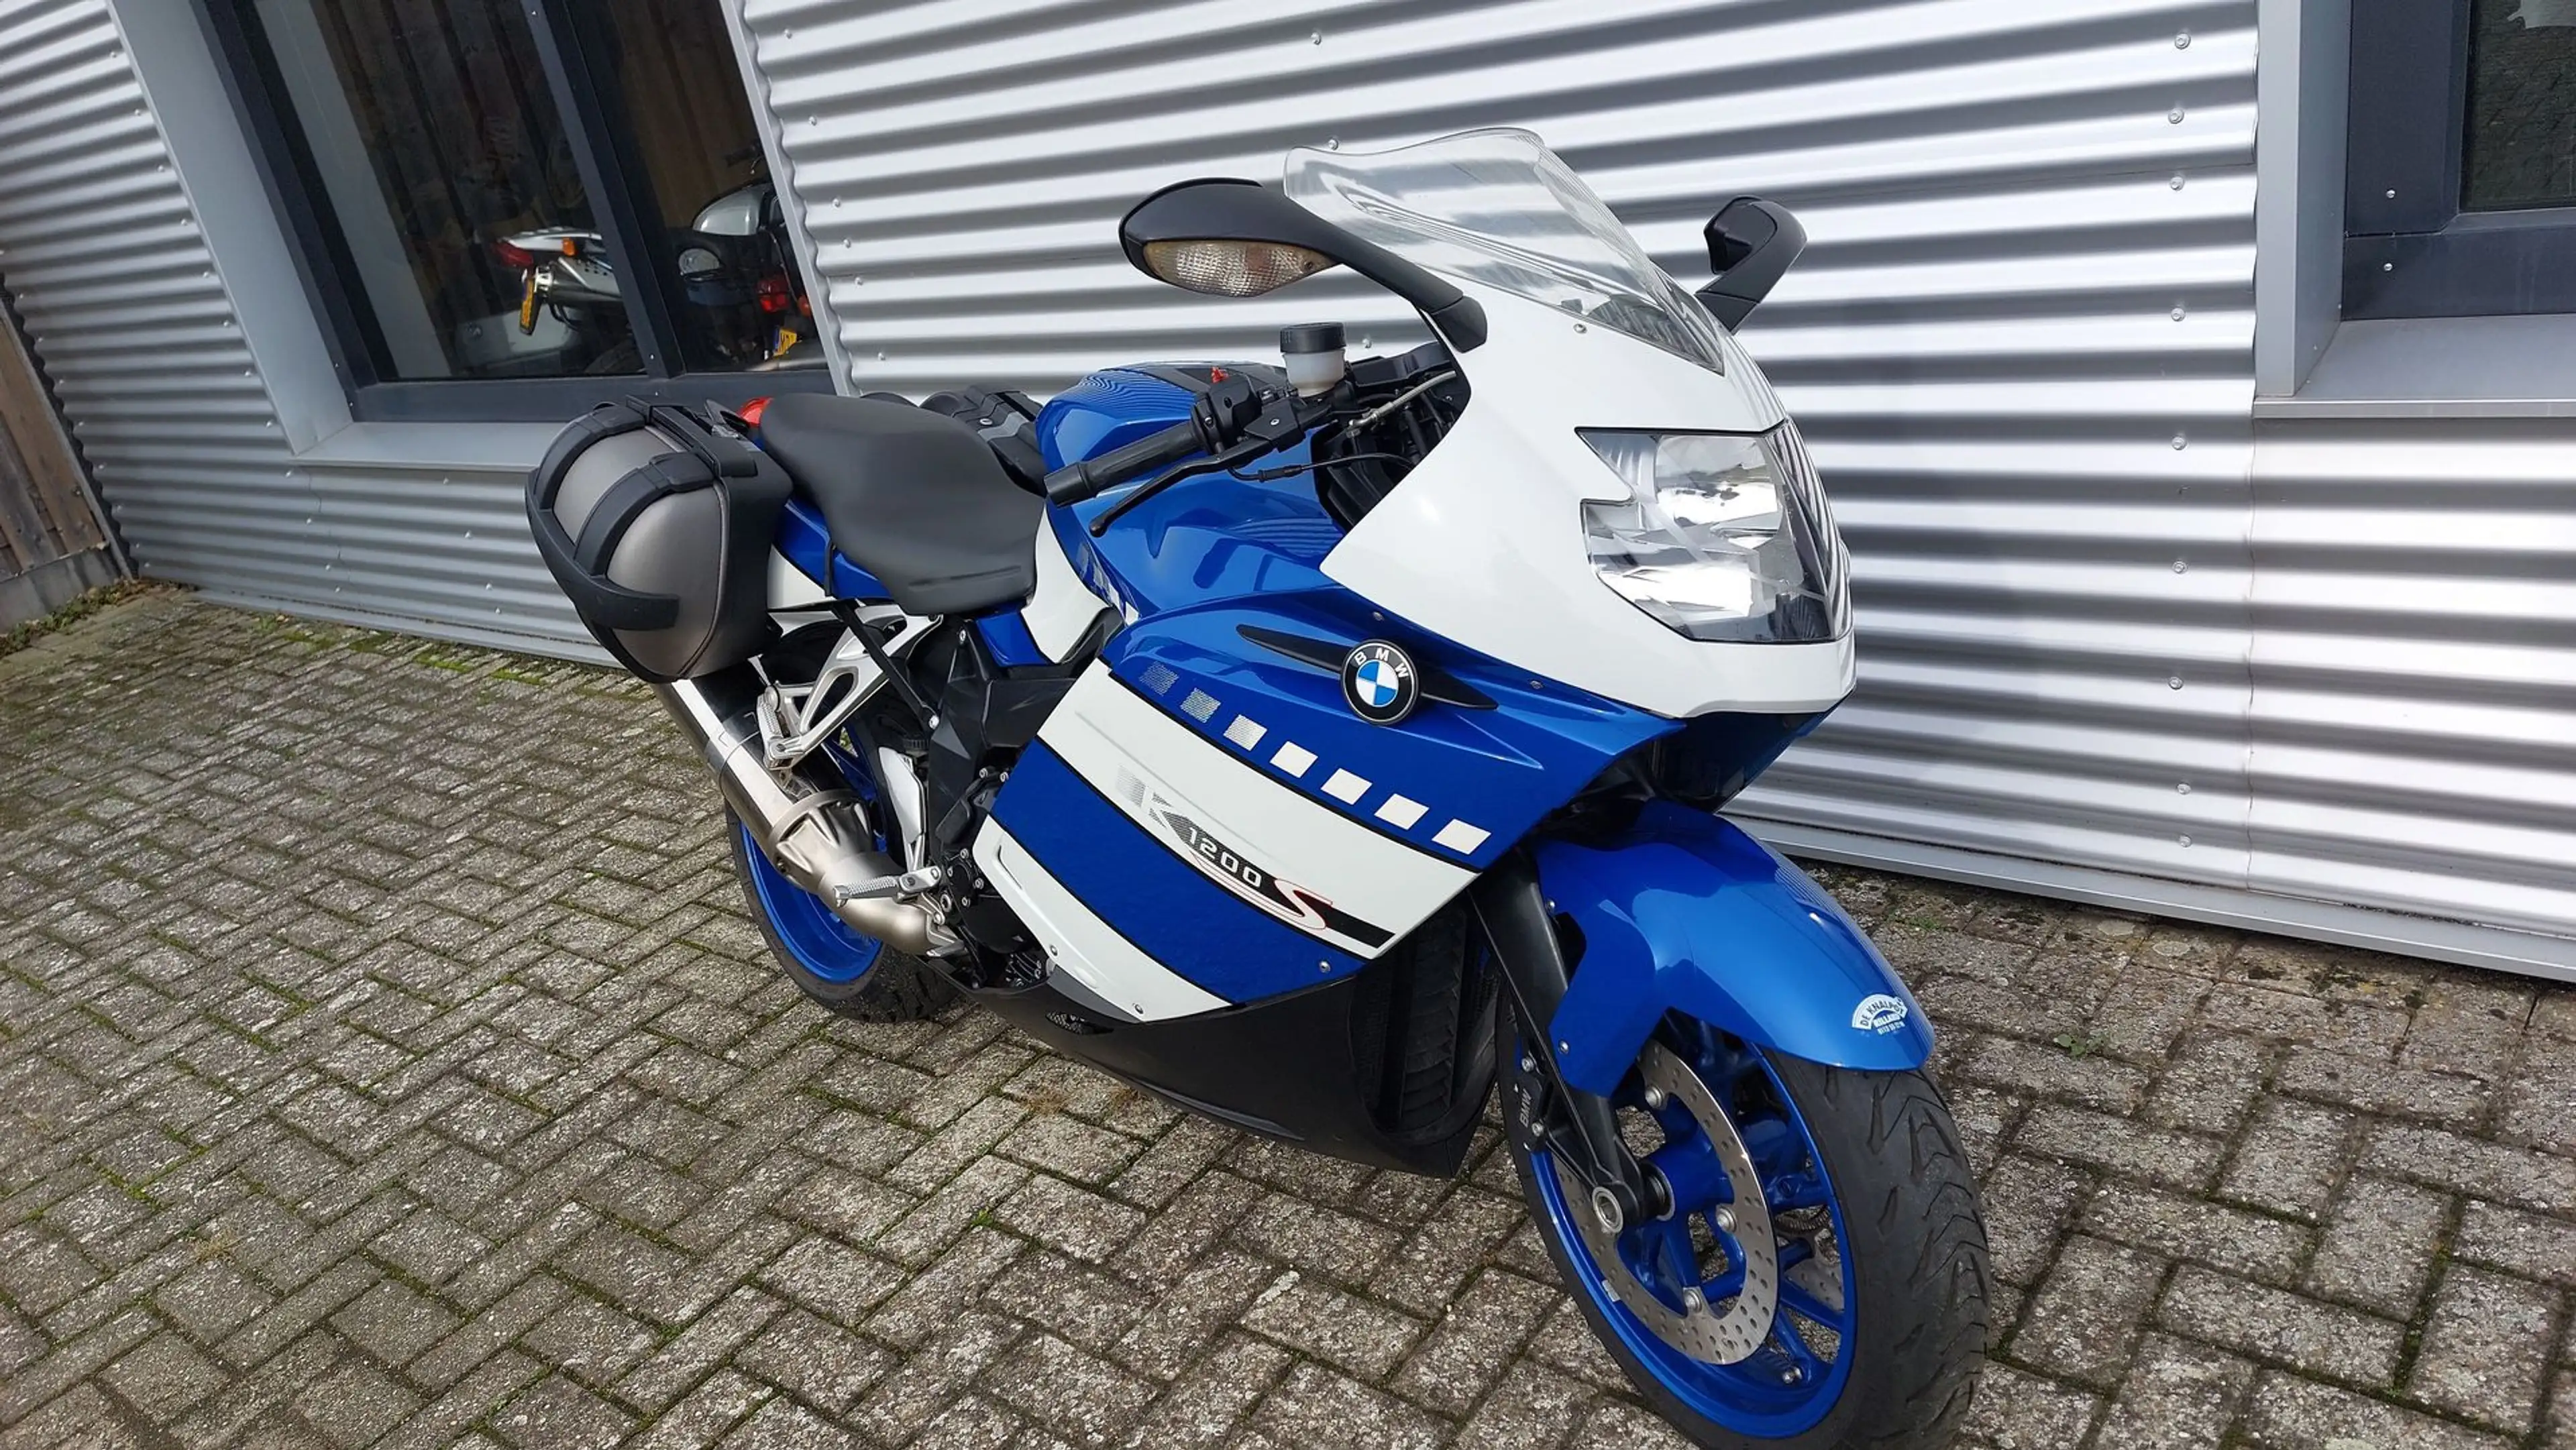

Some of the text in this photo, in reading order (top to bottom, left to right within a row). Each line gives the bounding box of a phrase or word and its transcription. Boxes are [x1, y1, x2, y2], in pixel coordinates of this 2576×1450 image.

[1354, 647, 1409, 678] BMW
[1188, 826, 1262, 889] 1200
[1274, 877, 1334, 931] S
[1860, 1014, 1872, 1027] DE
[1519, 1087, 1532, 1129] BMW
